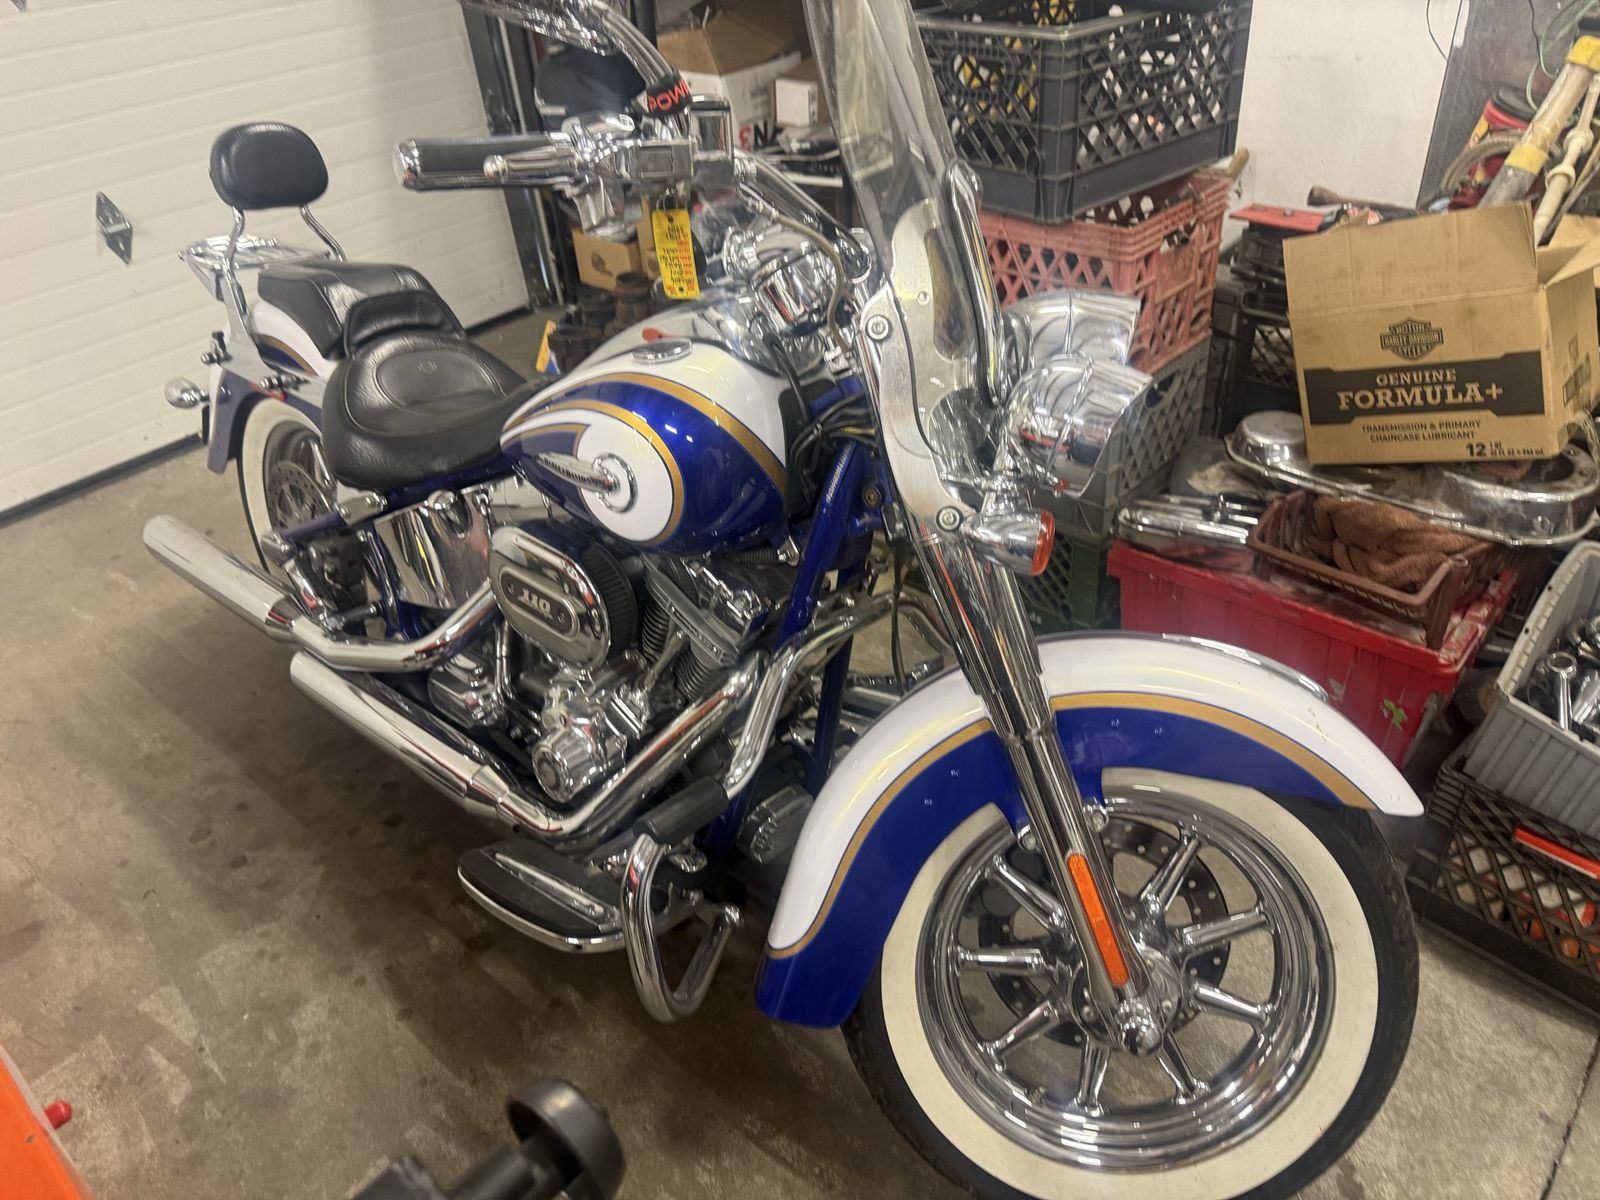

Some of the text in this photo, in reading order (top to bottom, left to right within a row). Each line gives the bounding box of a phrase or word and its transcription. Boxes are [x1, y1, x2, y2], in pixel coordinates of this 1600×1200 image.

[1376, 368, 1457, 387] GENUINE
[1337, 382, 1503, 411] FORMULA+
[1361, 419, 1481, 433] TRANSMISSION & PRIMARY
[1370, 431, 1476, 443] CHAINCASE LUBRICANT
[1465, 442, 1487, 457] 12
